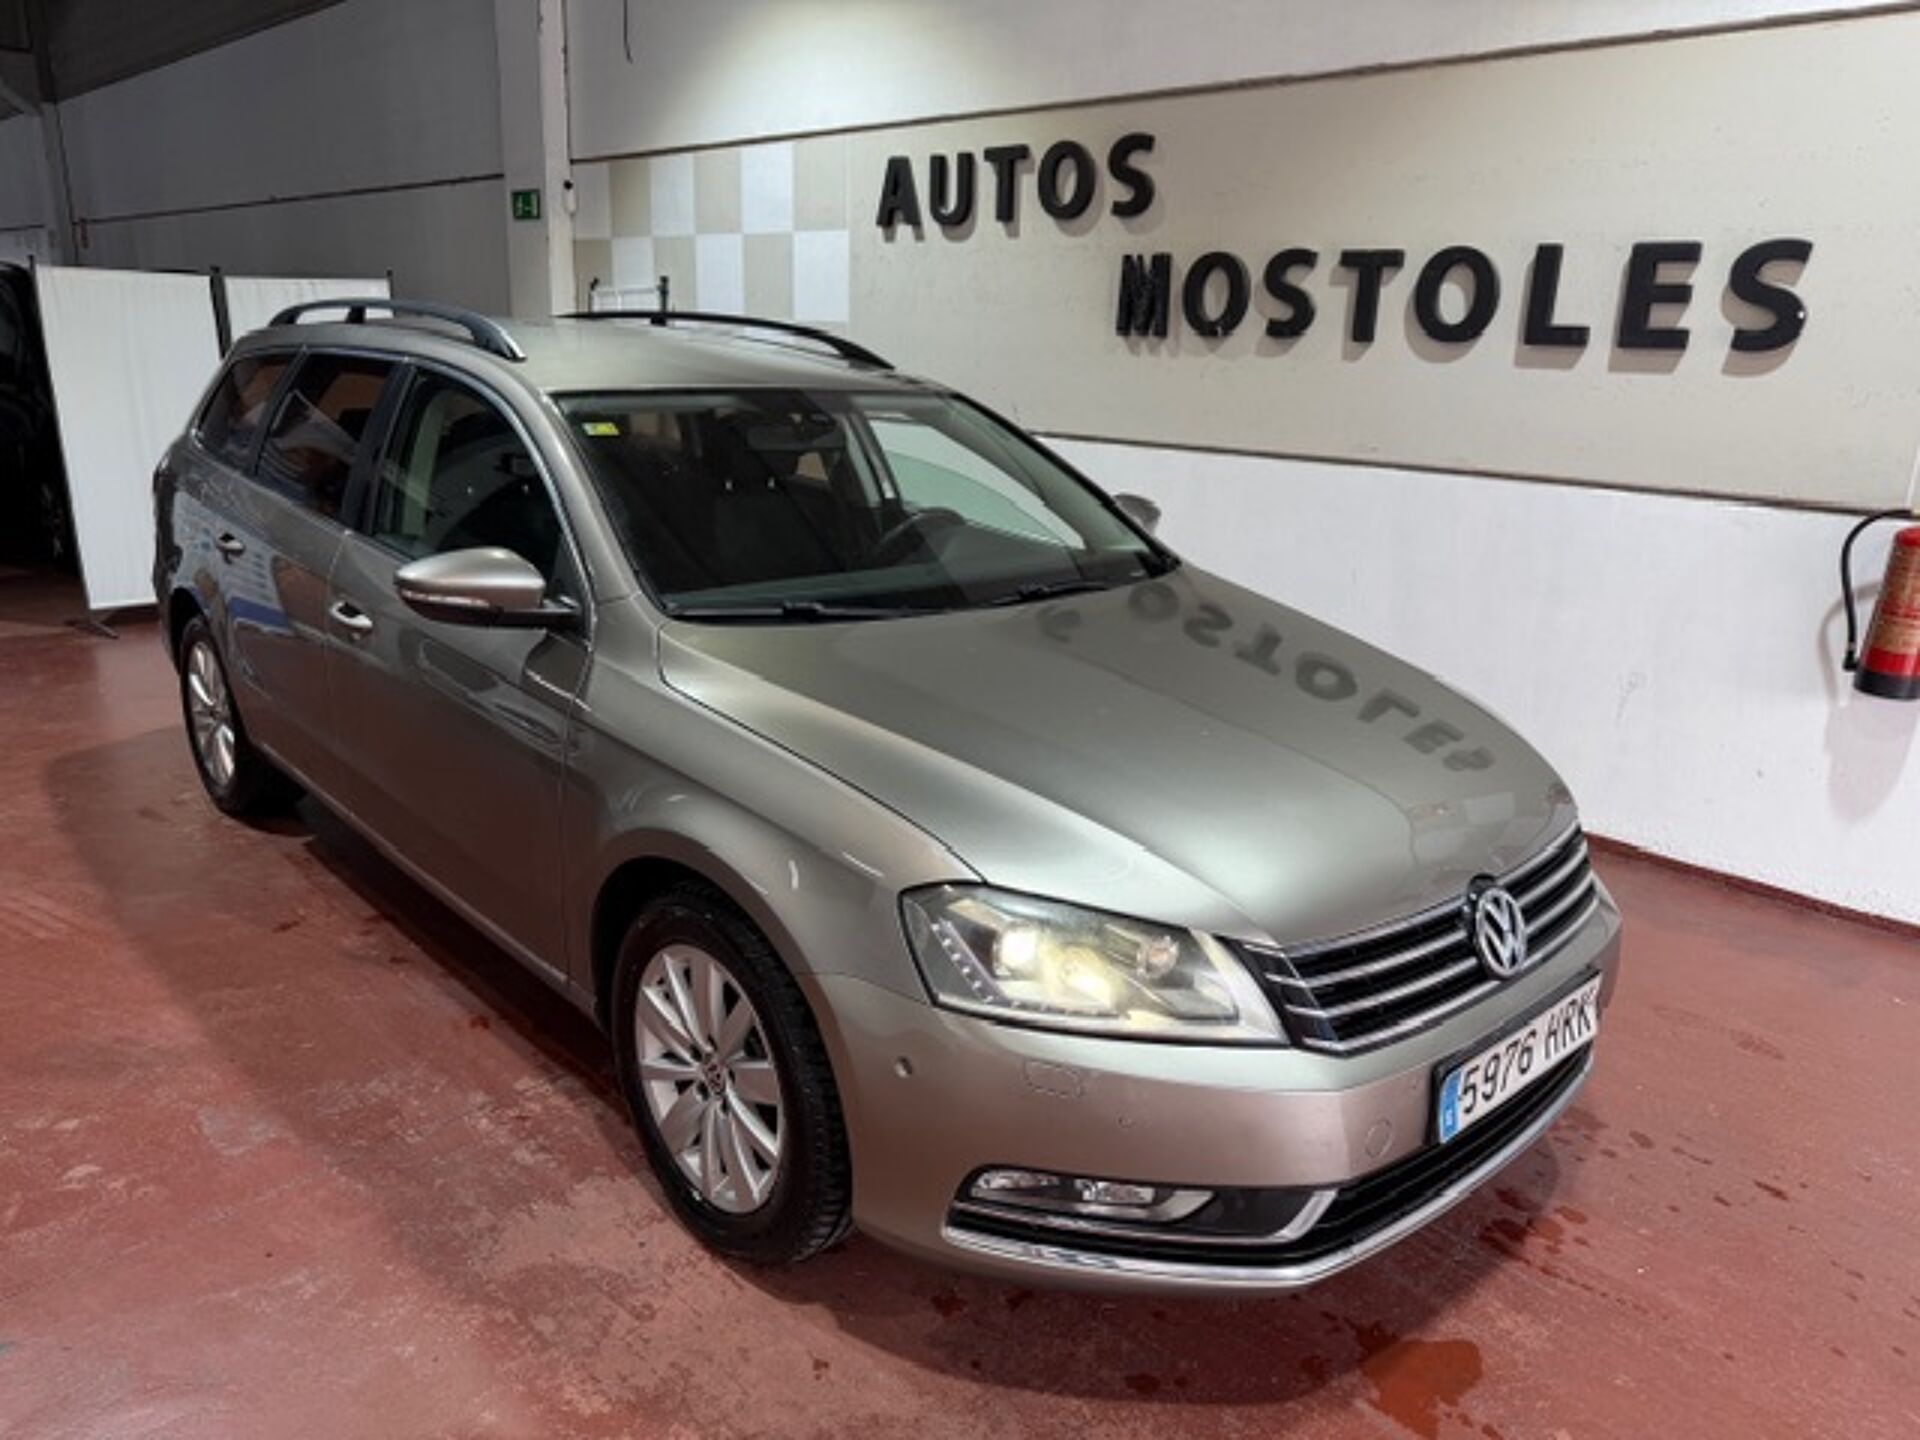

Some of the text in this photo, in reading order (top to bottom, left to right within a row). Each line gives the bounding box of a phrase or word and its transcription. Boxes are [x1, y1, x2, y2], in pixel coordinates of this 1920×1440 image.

[876, 132, 1157, 227] AUTOS
[1115, 239, 1814, 352] MOSTOLES
[1462, 985, 1597, 1115] 5976 HRK
